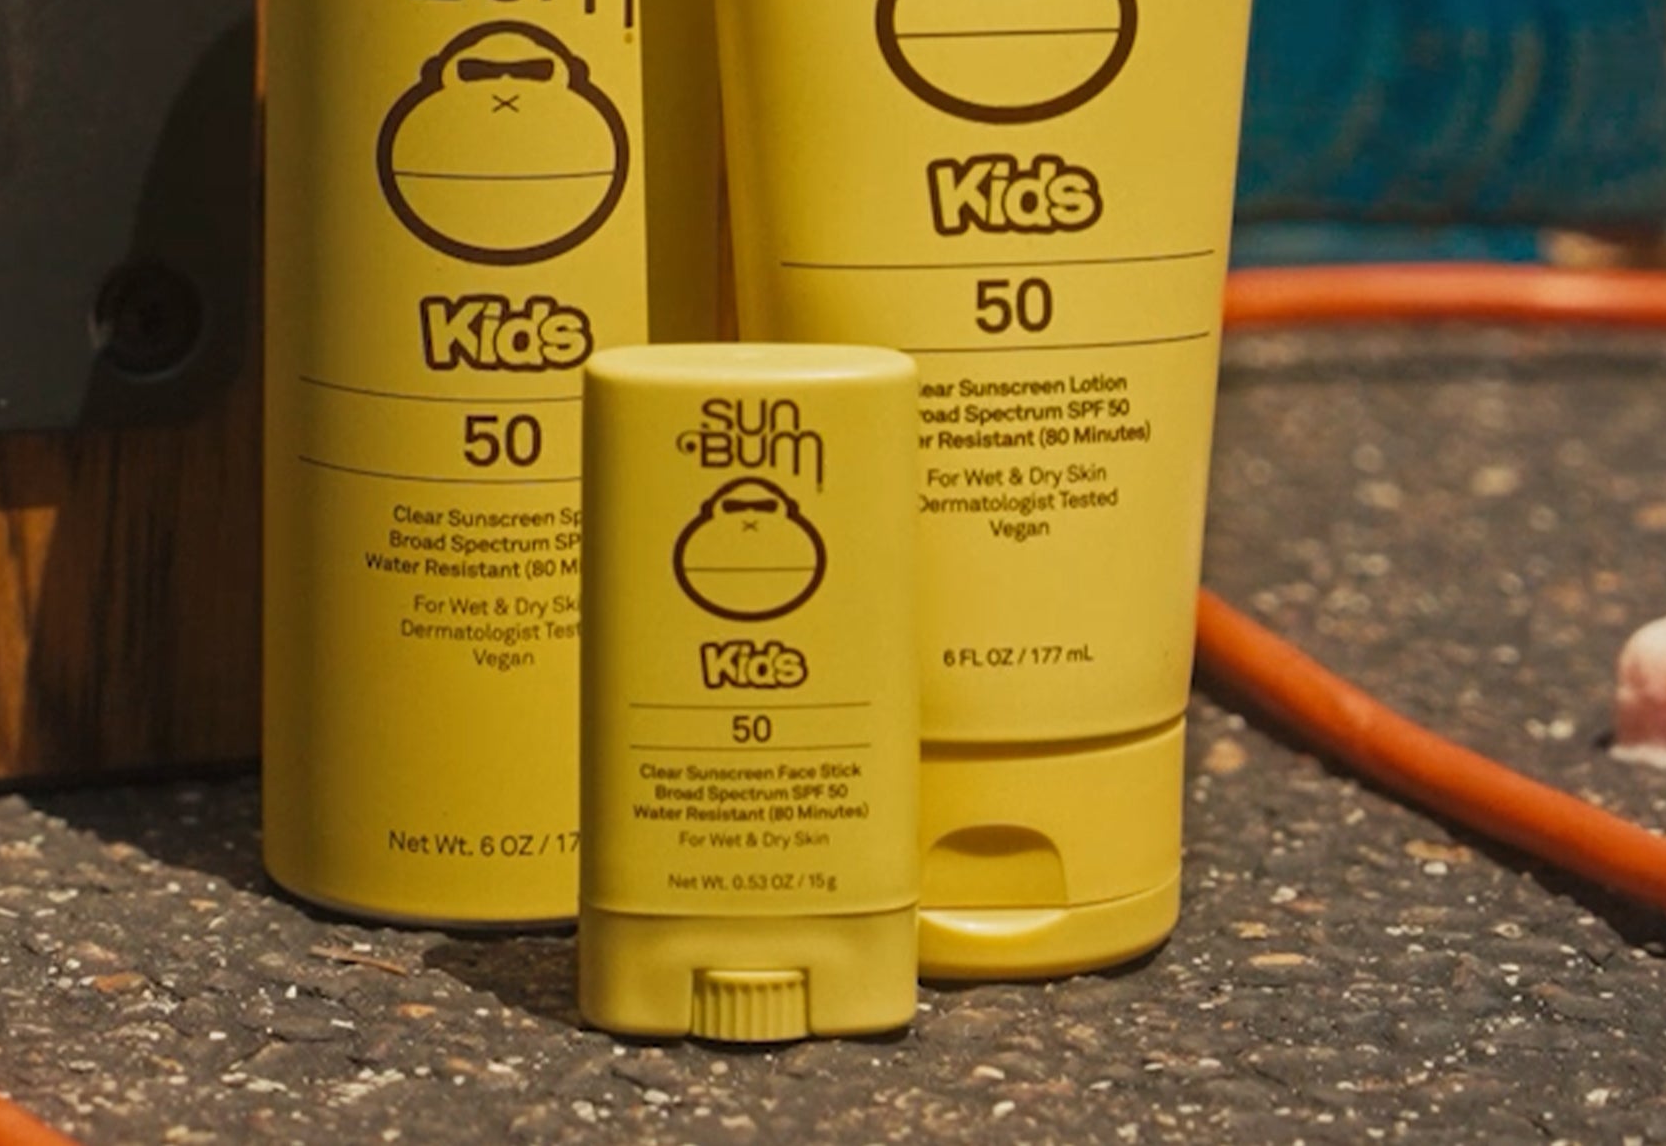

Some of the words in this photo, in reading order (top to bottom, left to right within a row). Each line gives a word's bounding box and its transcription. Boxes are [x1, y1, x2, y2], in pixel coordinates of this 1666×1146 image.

[927, 154, 1103, 236] Kids
[974, 278, 1054, 334] 50
[419, 294, 593, 372] Kids
[959, 378, 1064, 397] Sunscreen
[1070, 374, 1128, 394] Lotion
[965, 404, 1063, 426] Spectrum
[1067, 400, 1104, 420] SPF
[1108, 399, 1130, 416] 50
[463, 414, 541, 466] 50
[938, 430, 1035, 450] Resistant
[1039, 427, 1069, 449] (80
[1074, 420, 1151, 445] Minutes)
[927, 468, 960, 488] For
[965, 469, 1003, 487] Wet
[1009, 467, 1023, 486] &
[1029, 466, 1063, 489] Dry
[1067, 463, 1107, 483] Skin
[1059, 487, 1119, 509] Tested
[393, 504, 444, 525] Clear
[448, 508, 555, 528] Sunscreen
[389, 529, 445, 551] Broad
[450, 534, 550, 555] Spectrum
[989, 520, 1050, 542] Vegan
[365, 552, 420, 575] Water
[425, 558, 521, 579] Resistant
[524, 559, 556, 581] (80
[413, 594, 445, 614] For
[449, 597, 488, 616] Wet
[494, 597, 508, 616] &
[515, 596, 547, 619] Dry
[401, 618, 540, 646] Dermatologist
[473, 648, 534, 672] Vegan
[700, 640, 808, 689] Kids
[944, 648, 956, 667] 6
[959, 648, 983, 667] FL
[987, 647, 1013, 667] OZ
[1031, 646, 1062, 665] 177
[1066, 643, 1094, 662] mL
[732, 715, 771, 743] 50
[639, 762, 682, 780] Clear
[686, 764, 774, 781] Sunscreen
[778, 764, 816, 780] Face
[820, 762, 861, 780] Stick
[654, 784, 704, 801] Broad
[707, 785, 788, 803] Spectrum
[792, 784, 823, 801] SPF
[828, 783, 848, 799] 50
[633, 805, 682, 821] Water
[686, 805, 765, 822] Resistant
[769, 805, 794, 823] (80
[798, 802, 870, 821] Minutes)
[389, 830, 429, 853] Net
[435, 834, 473, 856] Wt.
[480, 835, 494, 857] 6
[501, 834, 534, 856] OZ
[679, 831, 706, 848] For
[710, 831, 741, 848] Wet
[746, 832, 757, 848] &
[763, 831, 791, 851] Dry
[794, 830, 830, 847] Skin
[668, 873, 697, 890] Net
[701, 875, 728, 891] Wt.
[732, 874, 768, 891] 0.53
[771, 874, 794, 891] OZ
